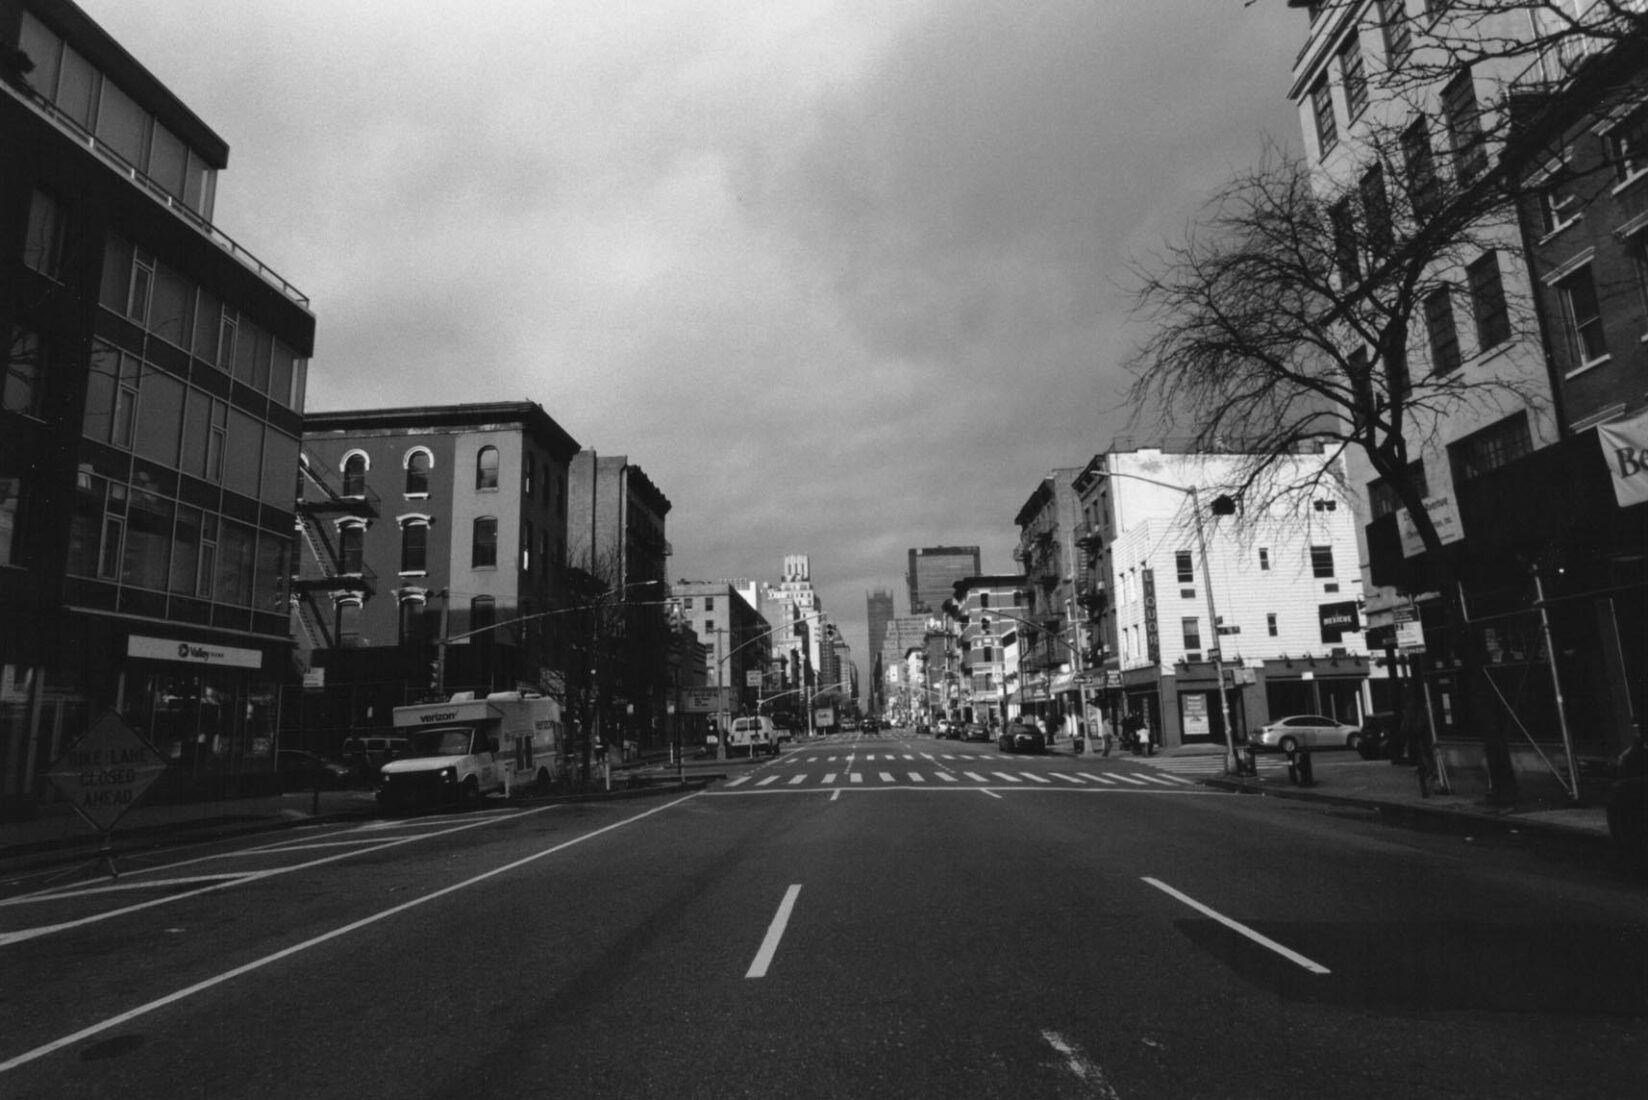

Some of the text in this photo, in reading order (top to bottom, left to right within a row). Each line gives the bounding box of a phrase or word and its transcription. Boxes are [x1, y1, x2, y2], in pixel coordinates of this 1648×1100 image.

[190, 646, 209, 661] Valley
[420, 711, 456, 722] verizon
[70, 748, 147, 767] BIKE LANE
[80, 768, 135, 786] CLOSED
[83, 790, 133, 806] AHEAD
